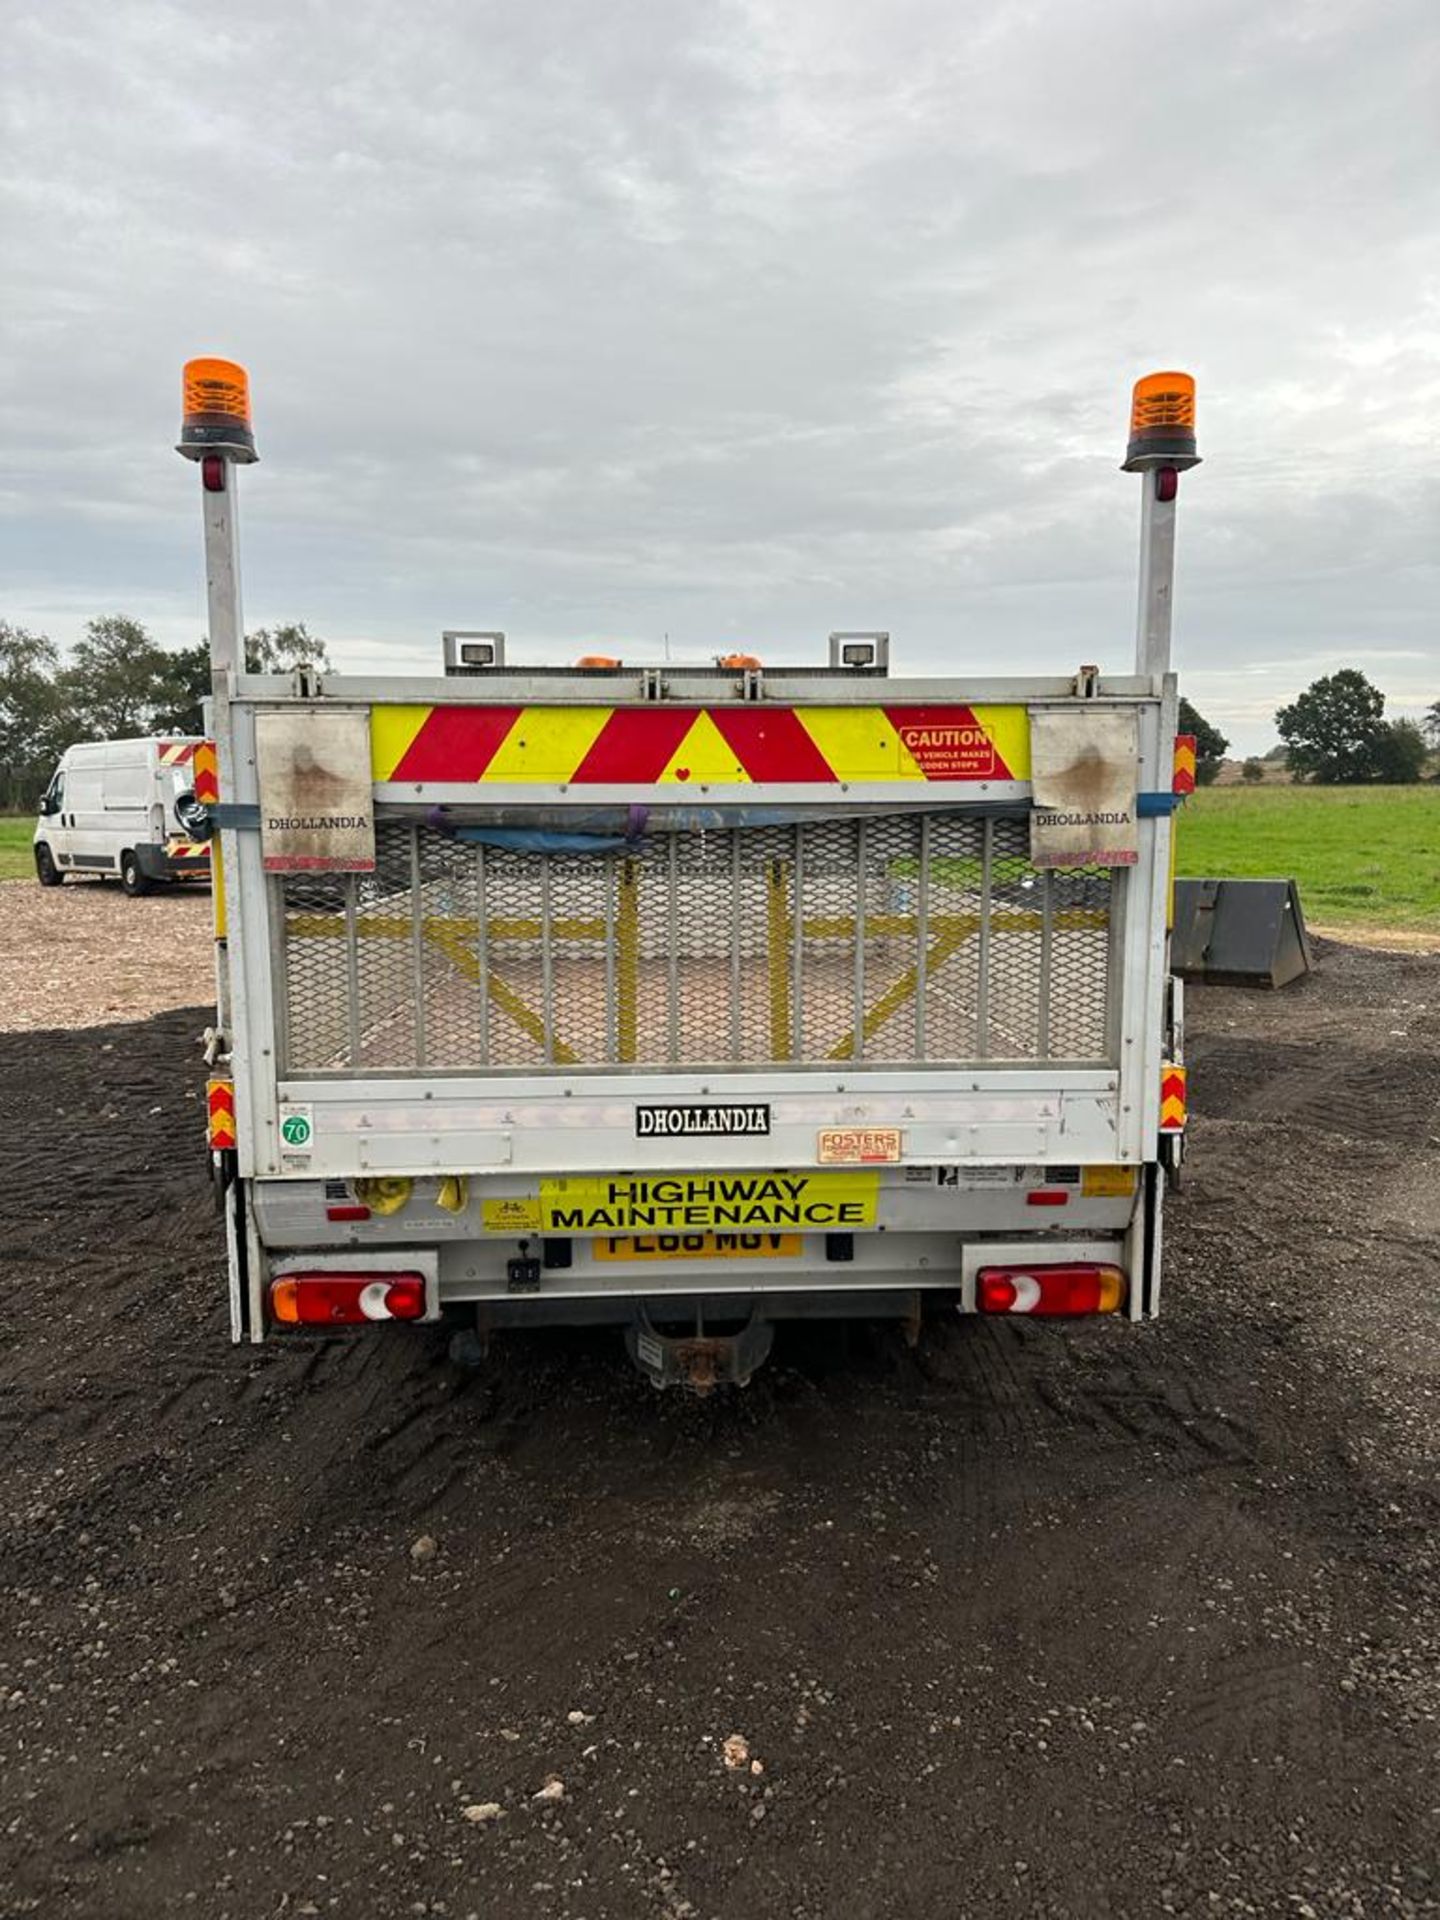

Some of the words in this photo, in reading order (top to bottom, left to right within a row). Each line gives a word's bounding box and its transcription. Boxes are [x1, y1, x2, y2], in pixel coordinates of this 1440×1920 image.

[906, 730, 988, 747] CAUTION
[922, 751, 959, 760] VEHICLE
[960, 750, 991, 758] MAKES
[916, 761, 949, 770] UDDEN
[950, 760, 979, 769] STOPS
[268, 816, 368, 830] DHOLLANDIA
[1036, 812, 1132, 827] DHOLLANDIA
[638, 1108, 768, 1134] DHOLLANDIA
[284, 1124, 308, 1141] 70
[822, 1133, 898, 1146] FOSTERS
[608, 1178, 810, 1205] HIGHWAY
[551, 1203, 865, 1229] MAINTENANCE
